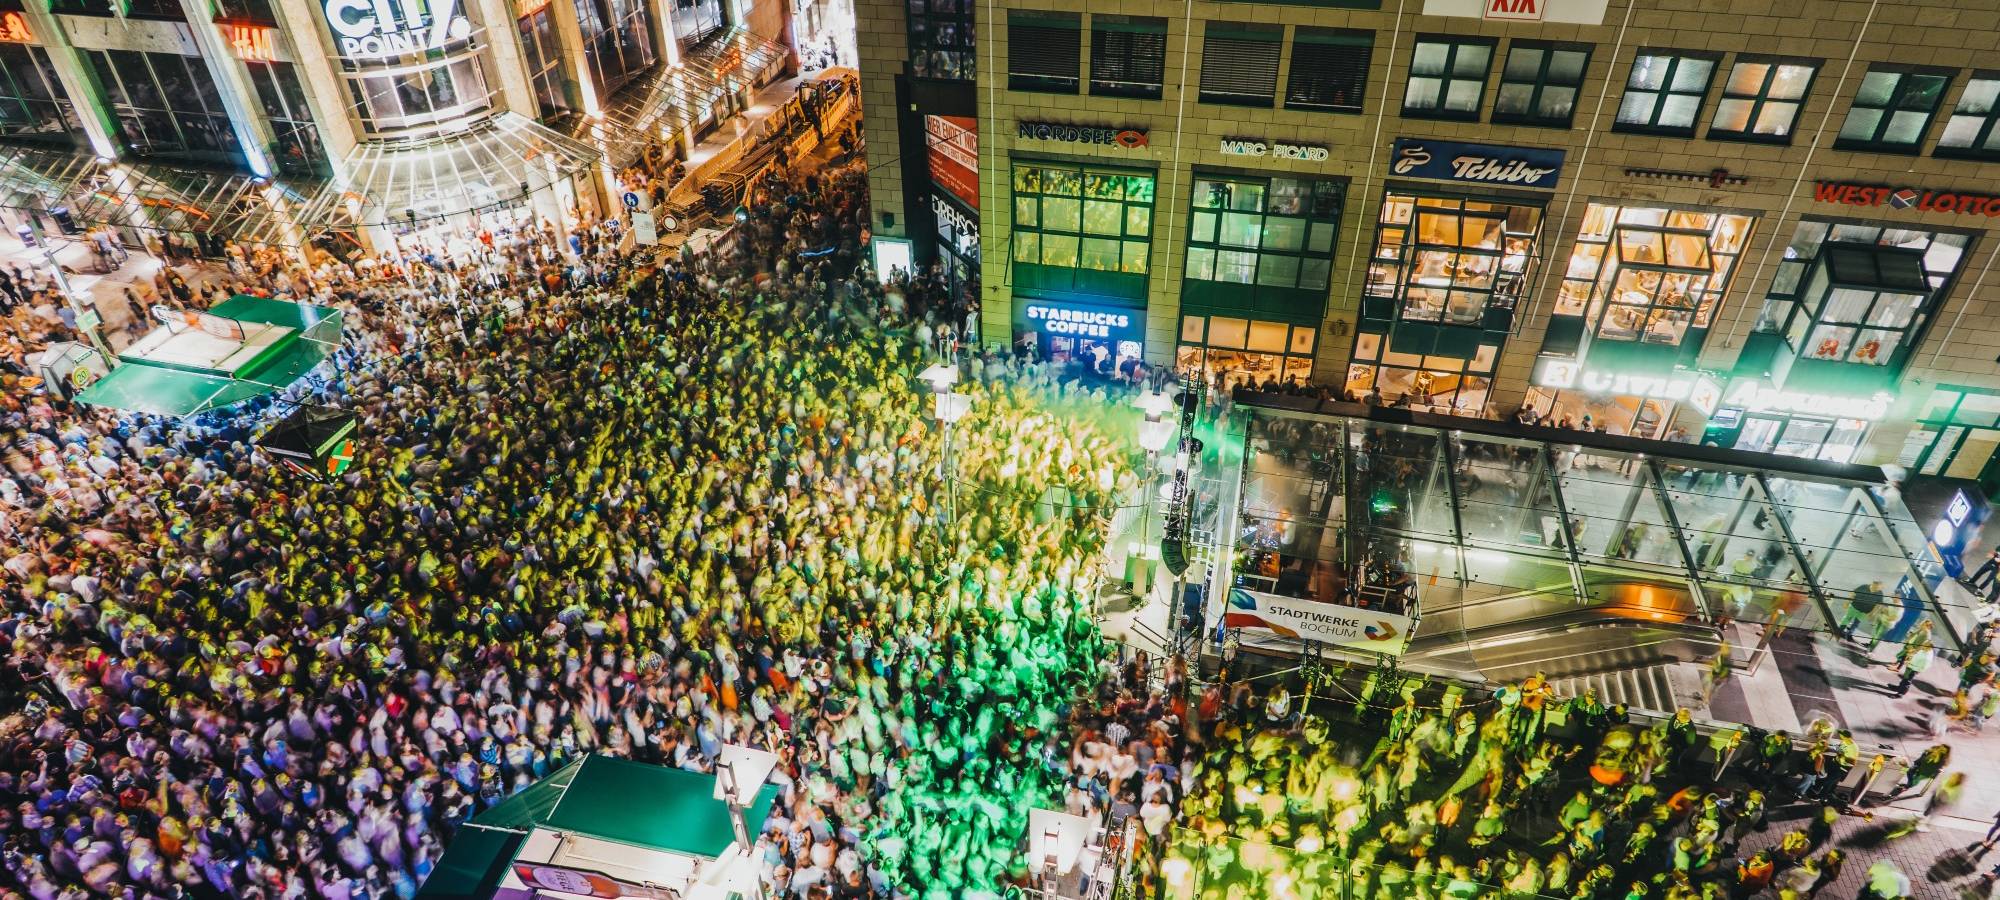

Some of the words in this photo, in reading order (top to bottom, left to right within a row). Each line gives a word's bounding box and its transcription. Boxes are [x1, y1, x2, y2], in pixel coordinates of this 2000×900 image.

[340, 28, 428, 57] POINT
[1019, 122, 1114, 146] NORDSEE
[1220, 140, 1267, 157] MARC
[1273, 144, 1329, 161] PICARD
[1452, 156, 1555, 184] Tchibo
[1814, 182, 1891, 208] WEST
[1917, 191, 2000, 218] LOTTO
[1027, 305, 1129, 328] STARBUCKS
[1045, 320, 1110, 338] COFFEE
[1268, 606, 1360, 628] STADTWERKE
[1300, 622, 1358, 638] BOCHUM
